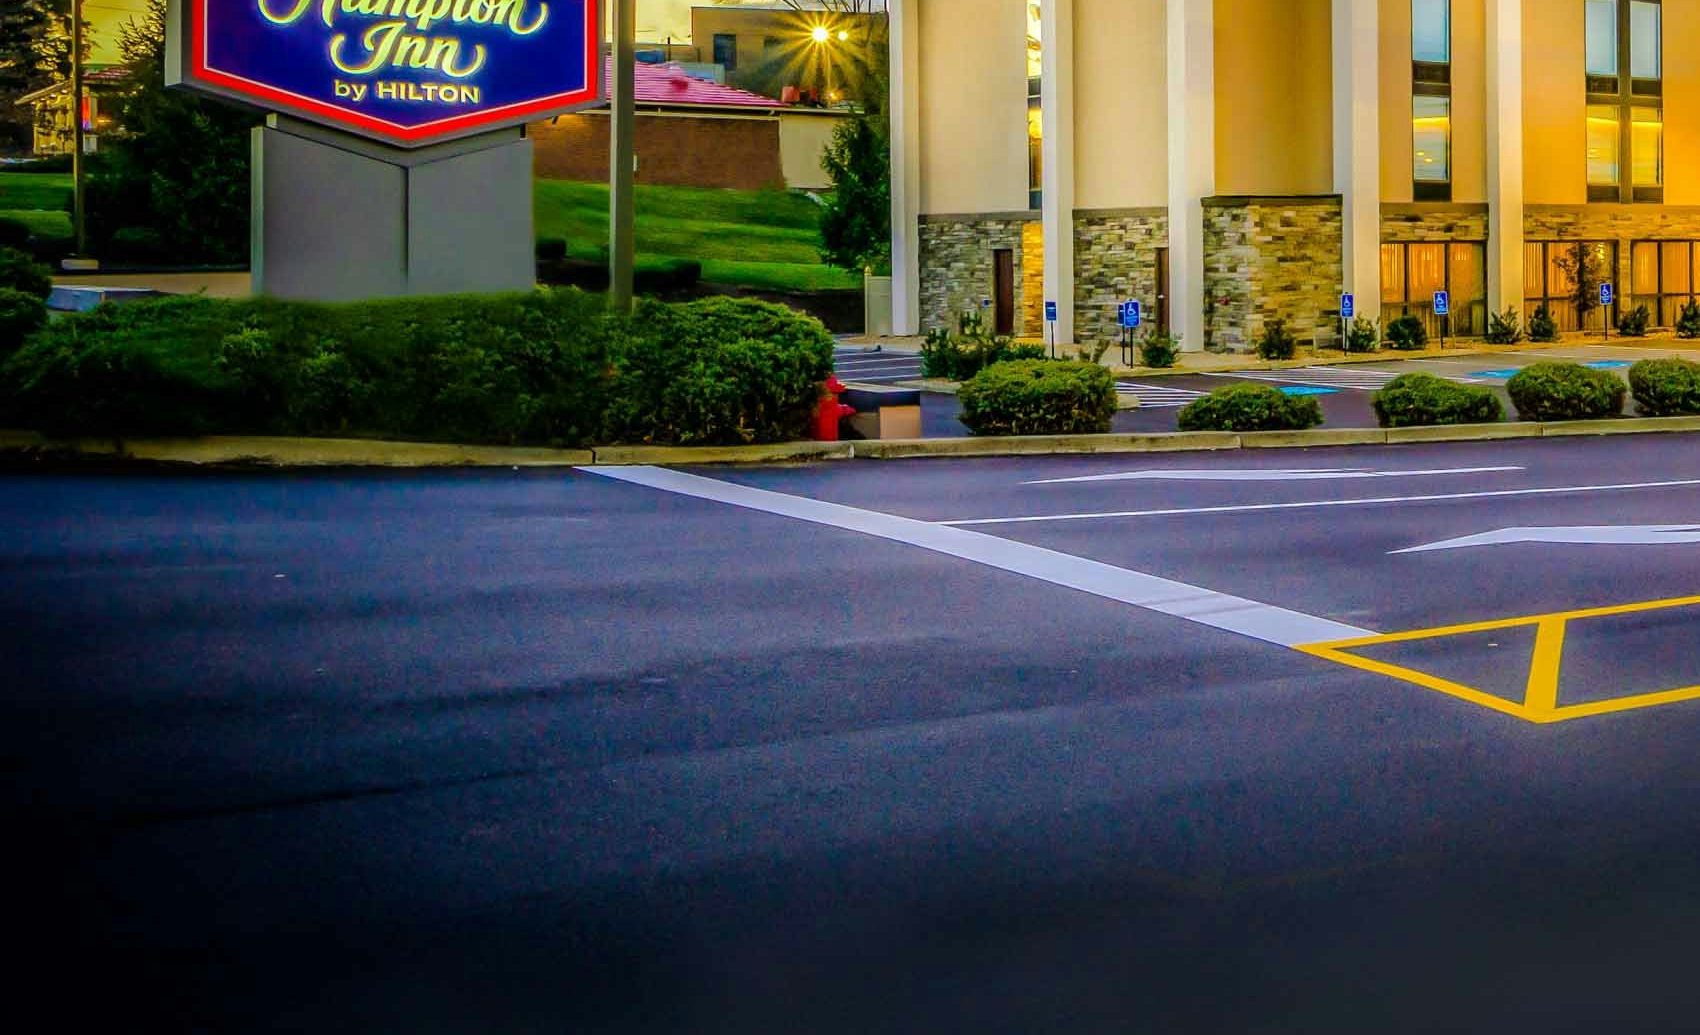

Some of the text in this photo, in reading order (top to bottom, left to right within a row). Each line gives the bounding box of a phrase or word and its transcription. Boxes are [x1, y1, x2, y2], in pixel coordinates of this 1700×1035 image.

[330, 21, 486, 78] Inn
[333, 79, 481, 104] by HILTON
